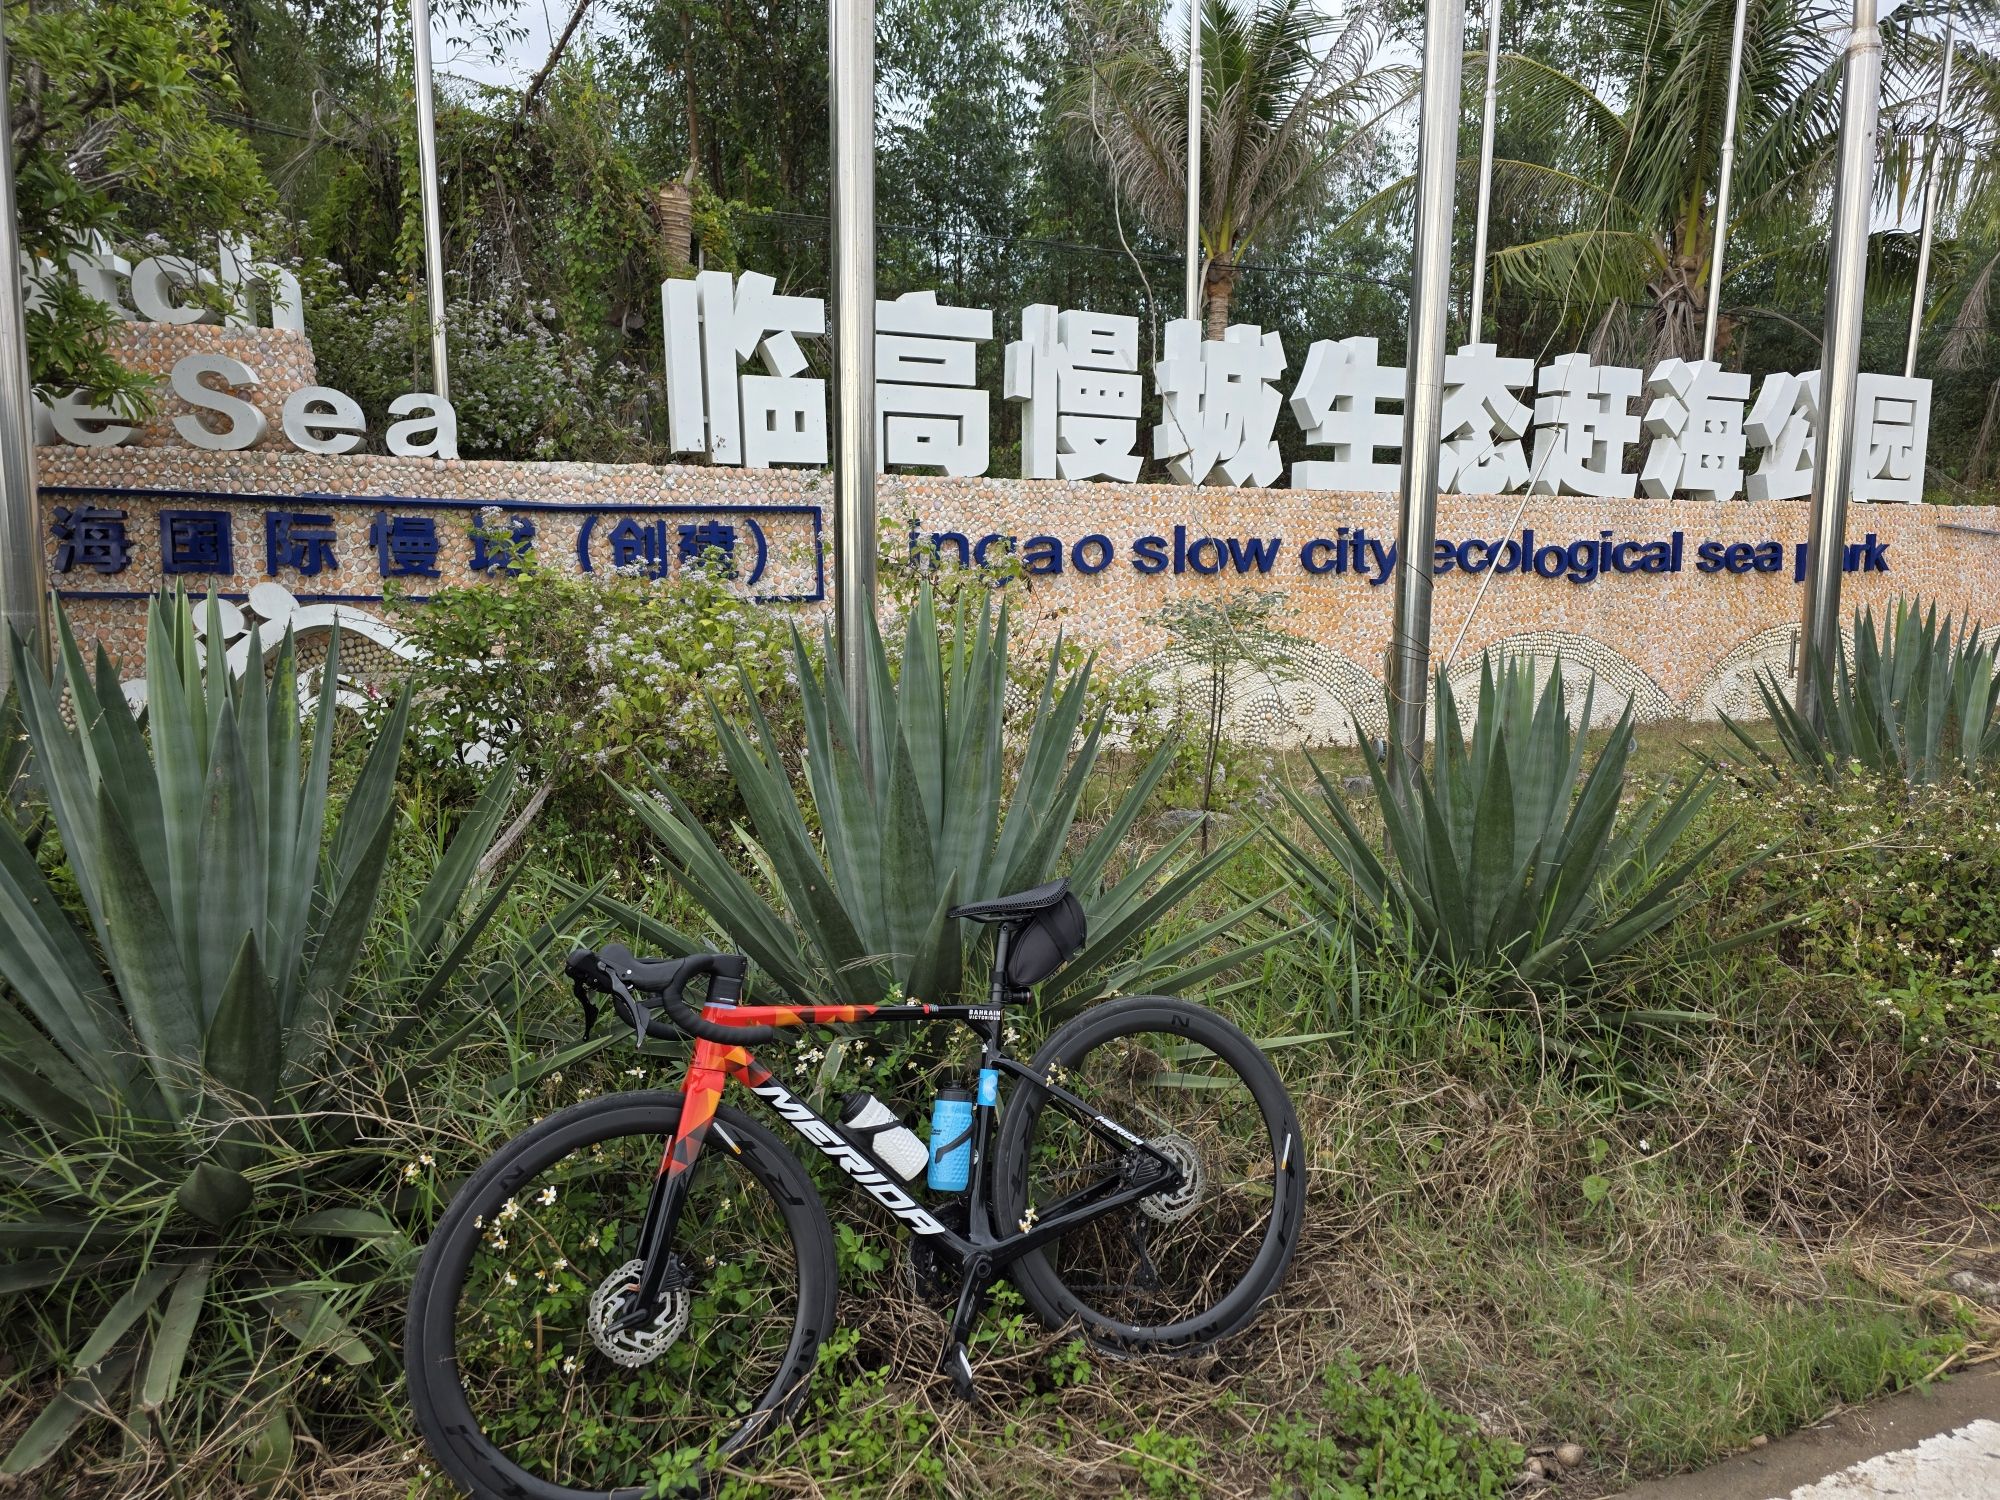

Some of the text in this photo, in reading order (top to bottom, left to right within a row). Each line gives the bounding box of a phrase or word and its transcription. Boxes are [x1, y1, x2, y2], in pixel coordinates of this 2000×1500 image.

[171, 354, 460, 460] Sea
[661, 269, 1933, 505] 临高慢城生态赶海公园
[908, 518, 1890, 587] ingao slow city ecological sea rk
[751, 1086, 946, 1235] MERIDA
[1094, 1115, 1144, 1145] MERIDA
